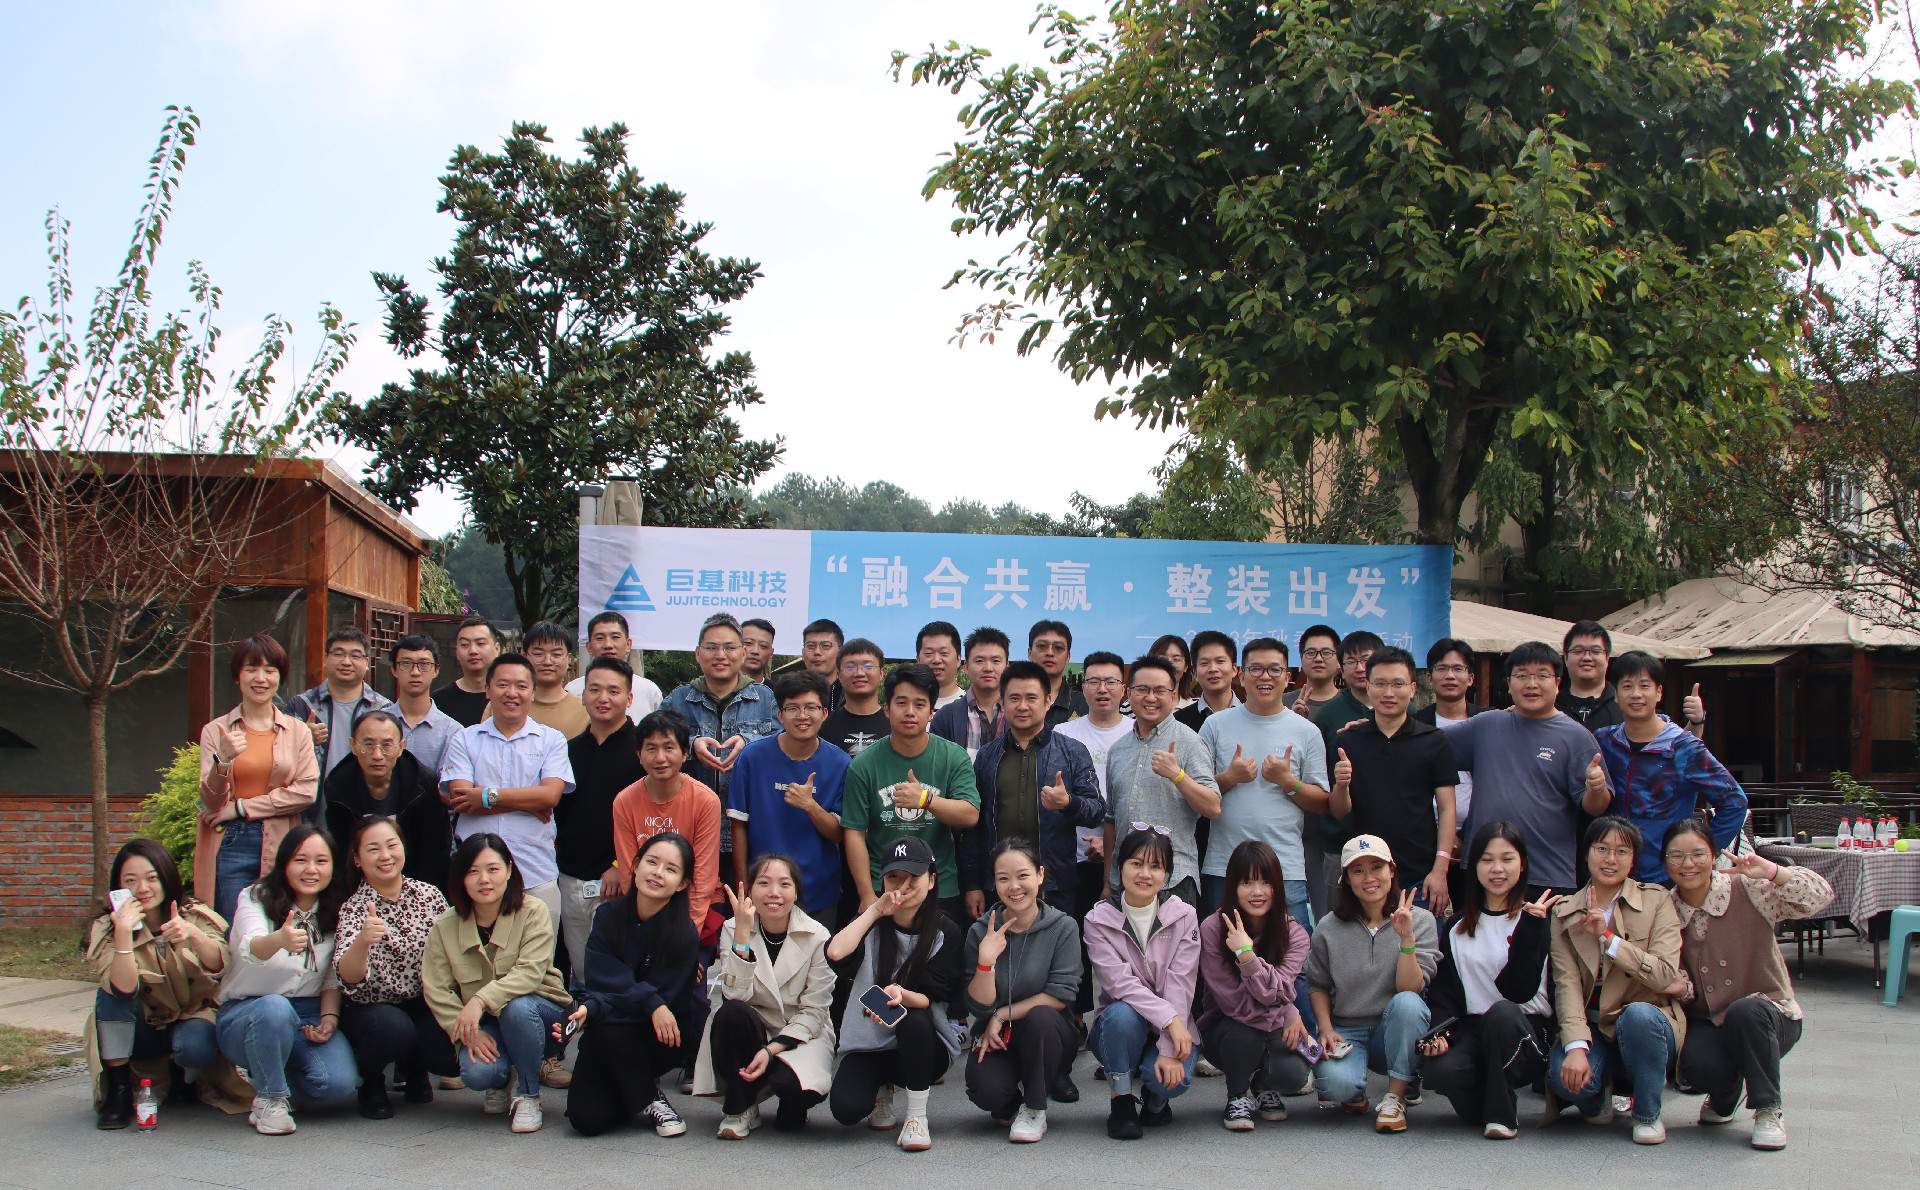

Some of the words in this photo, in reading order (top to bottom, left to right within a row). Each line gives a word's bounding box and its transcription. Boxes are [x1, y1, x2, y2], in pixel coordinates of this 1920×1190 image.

[665, 568, 787, 593] 巨基科技
[665, 595, 787, 608] JUJITECHNOLOGY
[644, 815, 674, 828] KNOCK
[894, 844, 907, 857] NY
